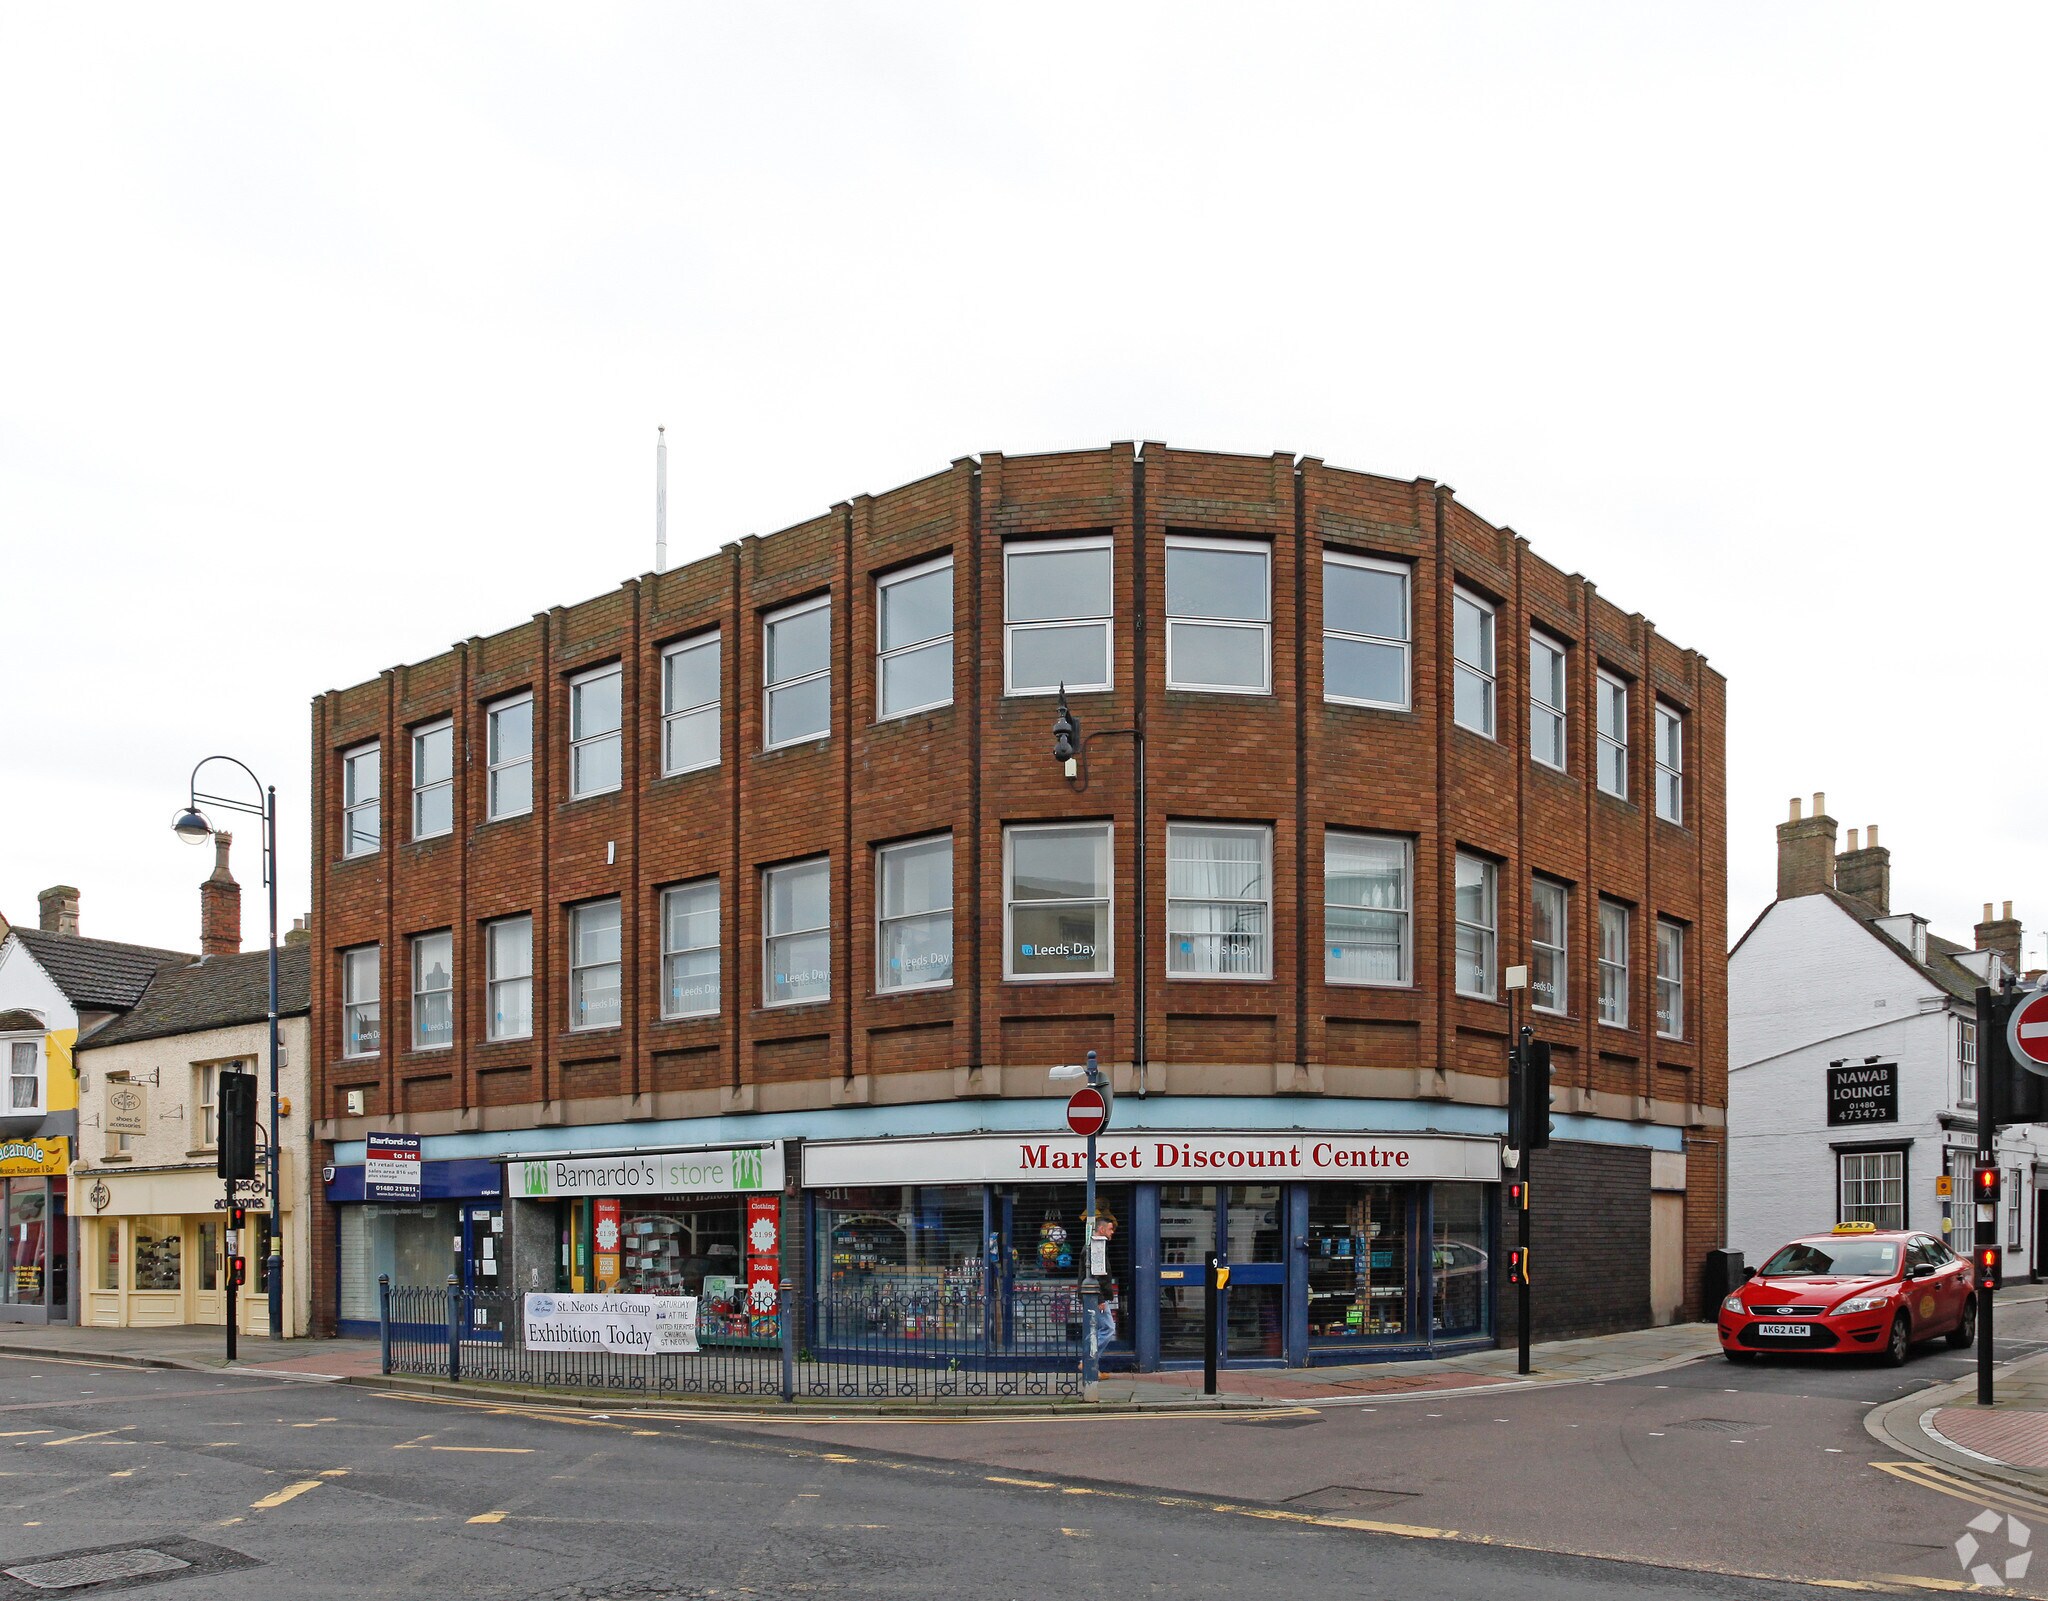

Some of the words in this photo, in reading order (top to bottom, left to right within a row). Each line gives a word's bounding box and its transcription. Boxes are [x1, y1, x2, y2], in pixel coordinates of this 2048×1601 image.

[785, 973, 809, 984] Leeds
[1837, 1069, 1888, 1084] NAWAB
[1834, 1085, 1891, 1100] LOUNGE
[1849, 1102, 1875, 1110] 01480
[1839, 1108, 1886, 1120] 473473
[1019, 1145, 1142, 1168] Market
[1154, 1143, 1301, 1168] Discount
[1312, 1143, 1409, 1167] Centre
[556, 1160, 654, 1187] Barnardo's
[670, 1162, 724, 1185] store
[224, 1180, 251, 1191] soes
[557, 1301, 568, 1312] St.
[571, 1301, 598, 1312] Neots
[602, 1302, 618, 1312] Art
[620, 1302, 650, 1316] Group
[529, 1323, 601, 1343] Exhibition
[606, 1324, 652, 1351] Today
[1763, 1326, 1786, 1334] AK62
